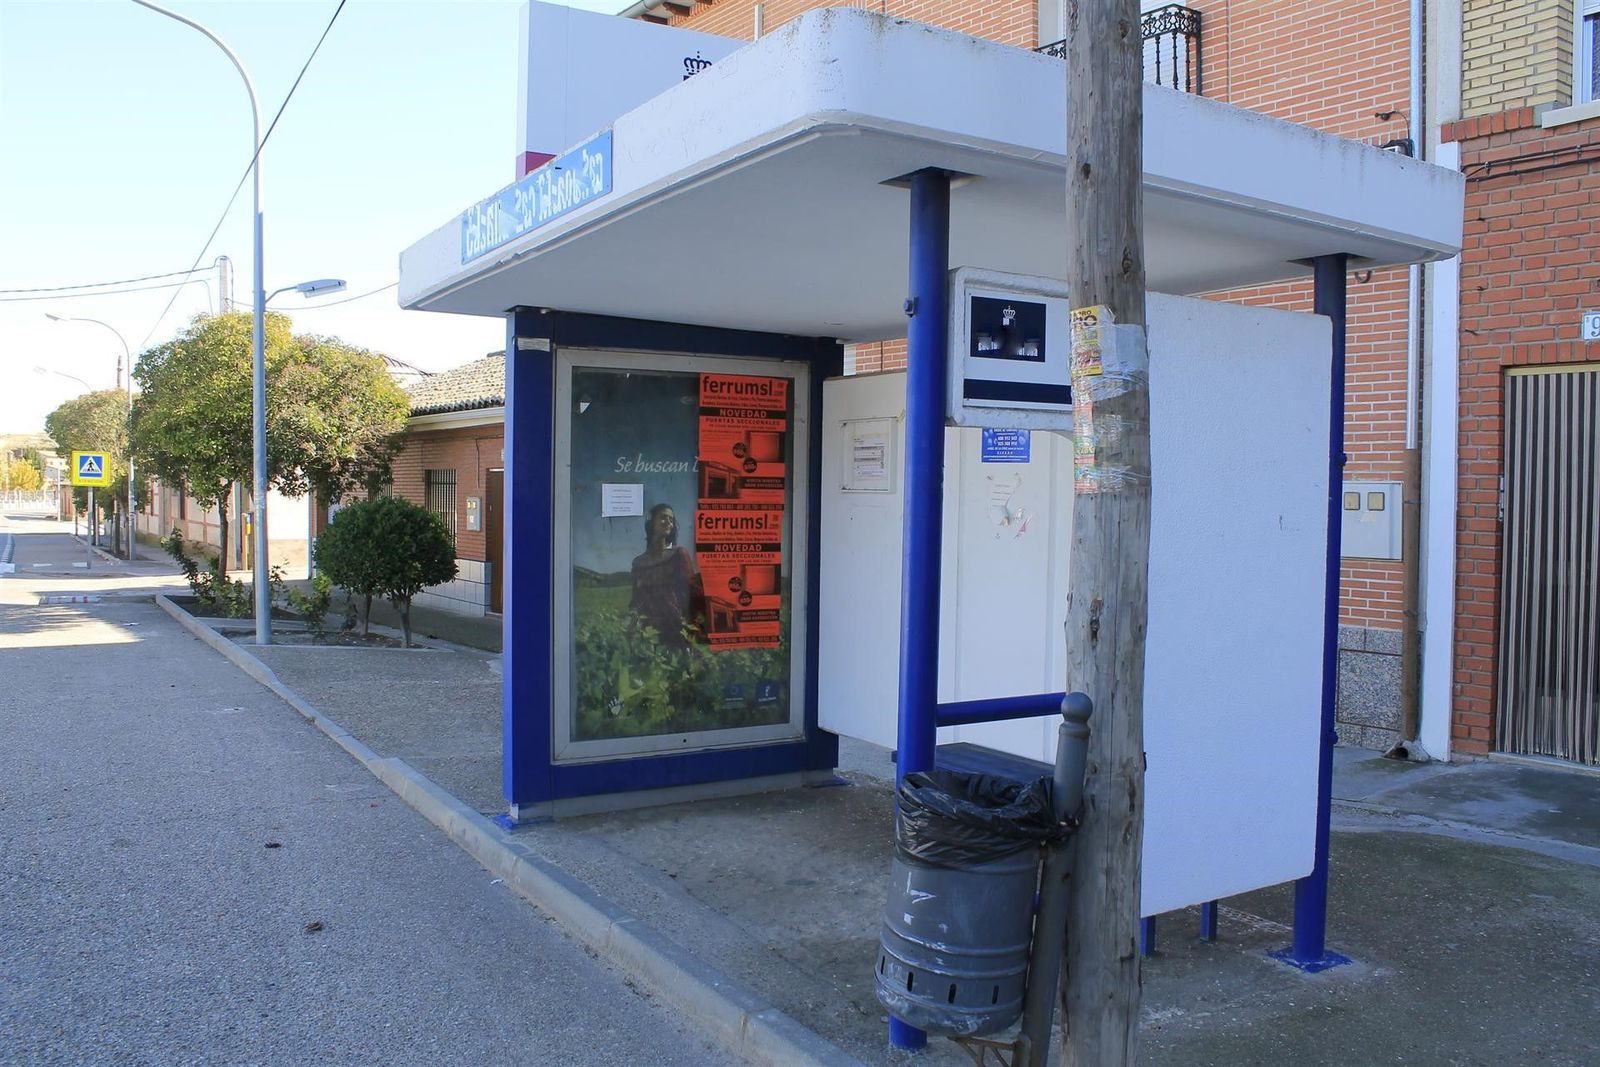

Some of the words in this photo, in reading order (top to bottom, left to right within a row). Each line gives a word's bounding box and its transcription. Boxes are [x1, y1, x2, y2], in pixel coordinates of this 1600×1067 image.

[703, 376, 772, 396] ferrumsl
[720, 408, 767, 418] NOVEDAD
[614, 456, 633, 473] Se
[635, 453, 688, 473] buscan
[698, 513, 768, 529] ferrumsl
[714, 544, 762, 552] NOVEDAD
